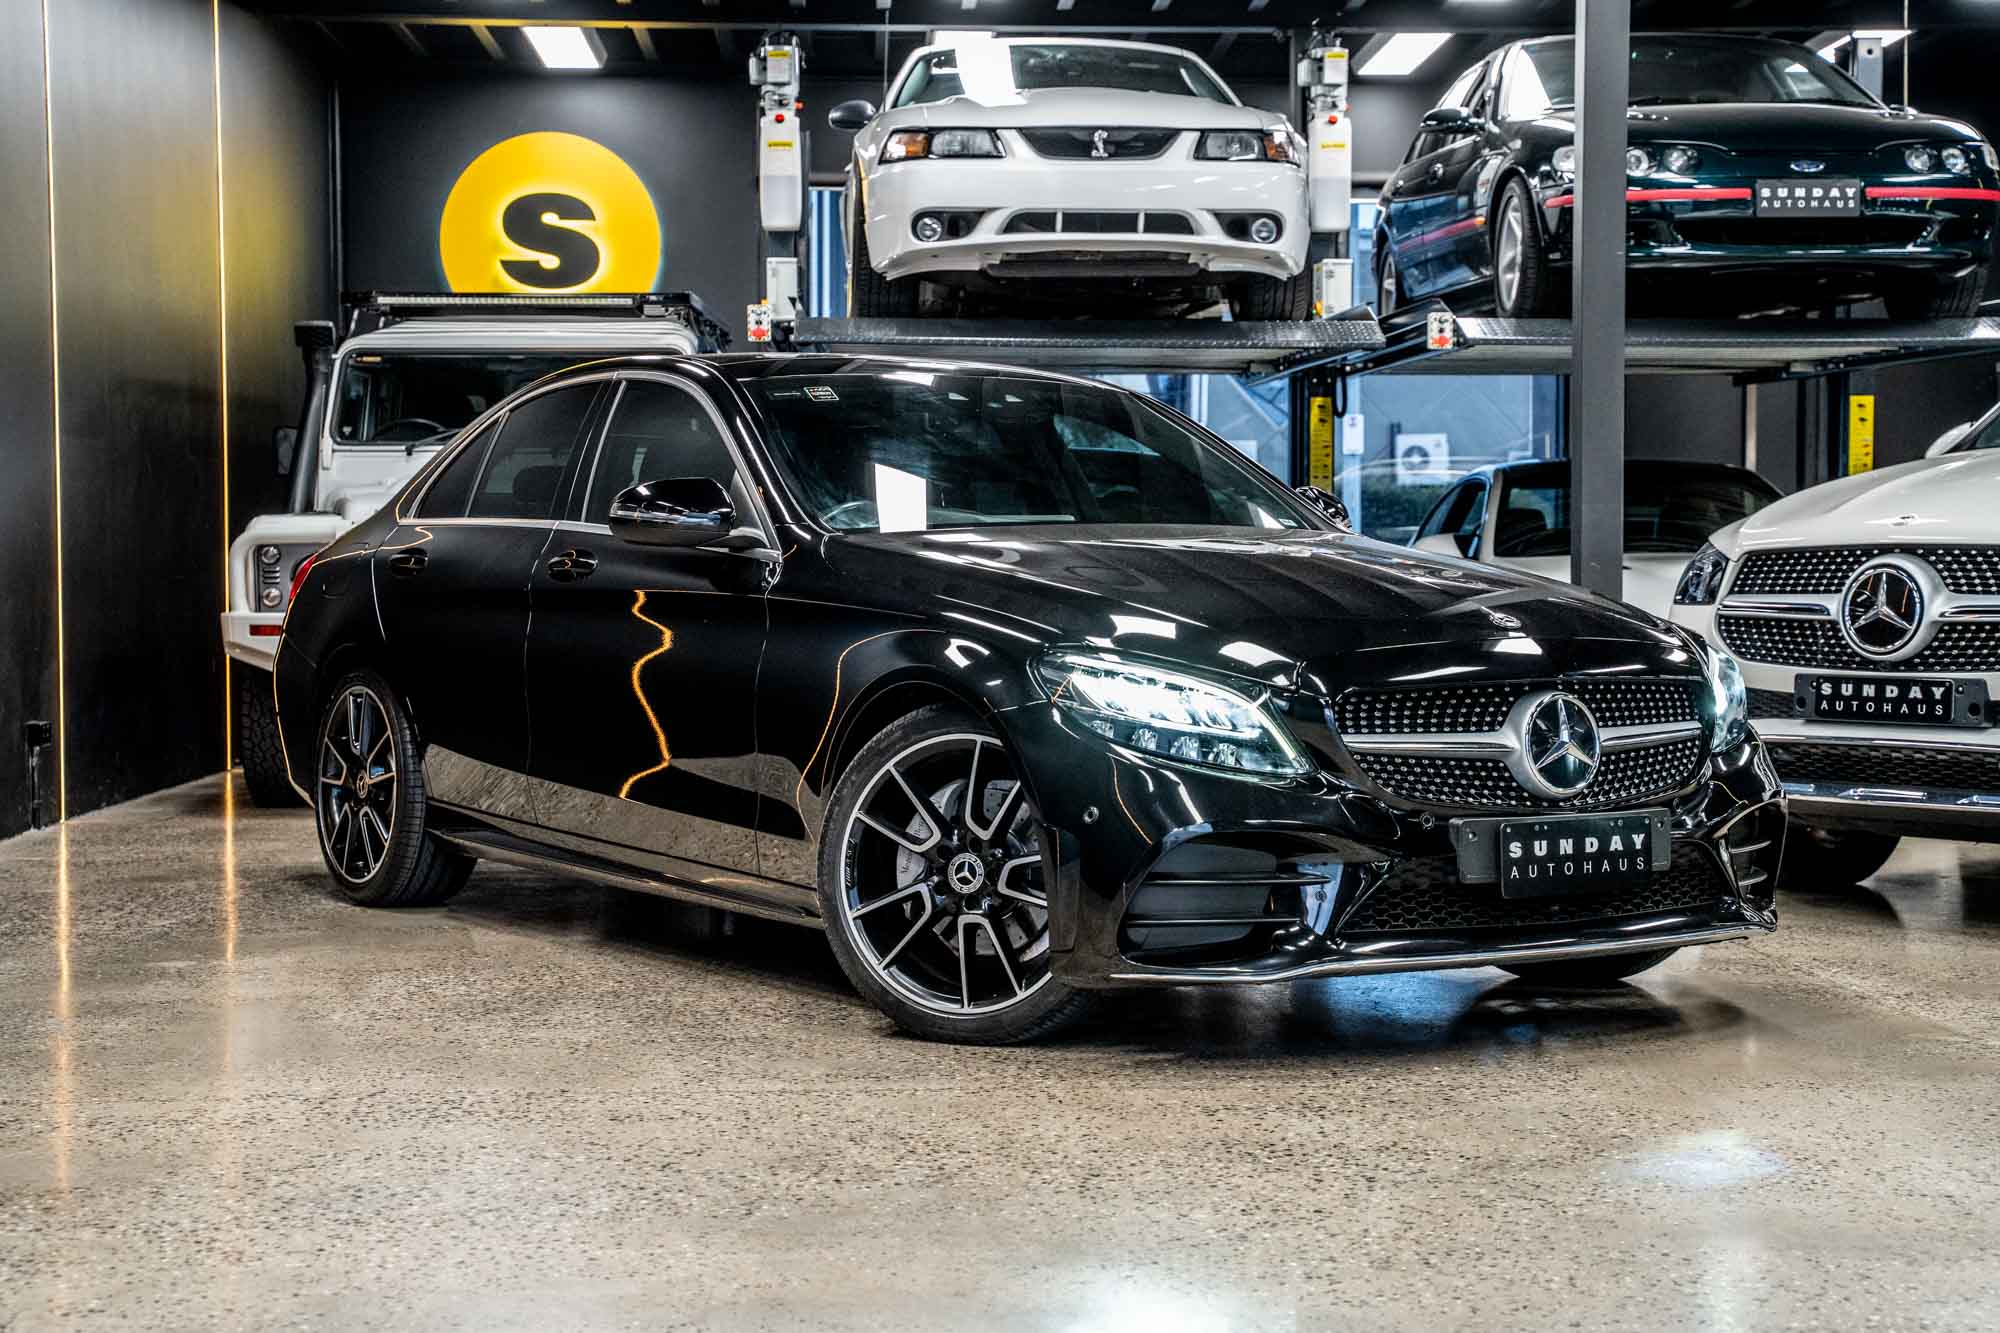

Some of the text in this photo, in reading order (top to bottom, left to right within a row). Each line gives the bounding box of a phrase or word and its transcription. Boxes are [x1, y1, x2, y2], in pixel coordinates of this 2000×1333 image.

[1760, 187, 1857, 198] SUNDAY
[1760, 199, 1855, 208] AUTOHAUS
[500, 192, 600, 289] S
[1820, 682, 1946, 700] SUNDAY
[1820, 700, 1943, 715] AUTOHAUS
[1508, 833, 1646, 859] SUNDAY
[1510, 856, 1645, 879] AUTOHAUS
